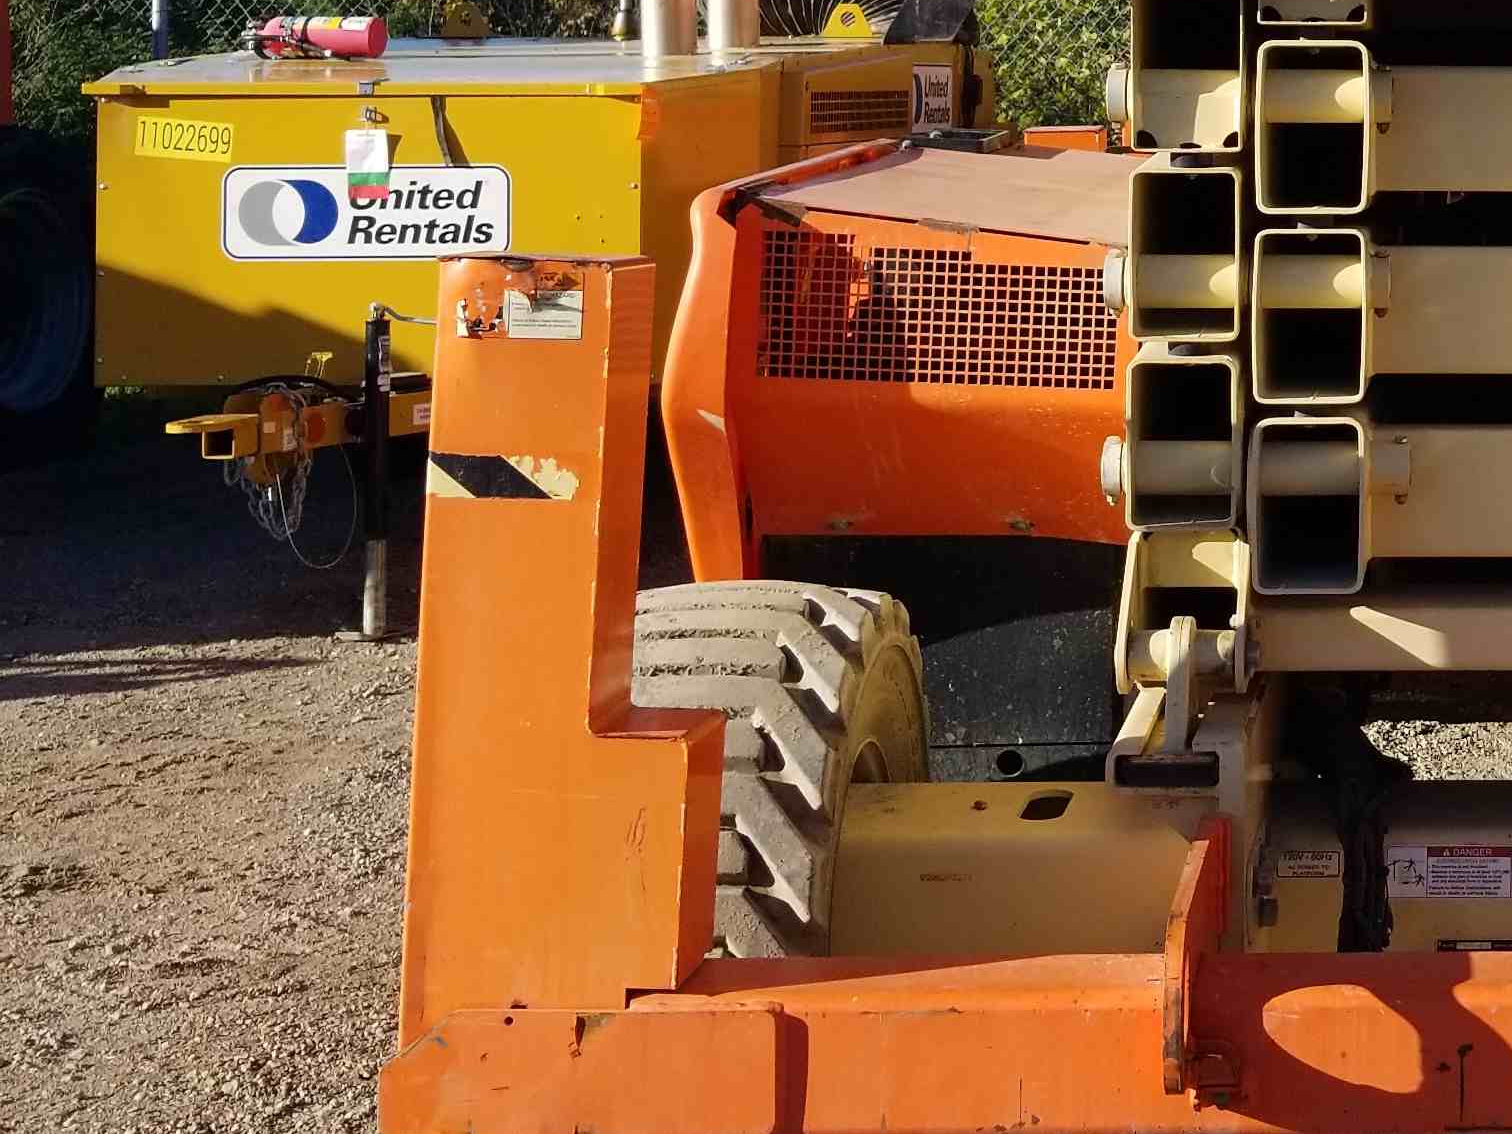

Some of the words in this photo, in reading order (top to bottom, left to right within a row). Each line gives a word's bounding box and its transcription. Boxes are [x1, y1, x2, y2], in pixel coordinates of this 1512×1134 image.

[924, 74, 949, 98] United
[924, 100, 950, 123] Rentals
[140, 120, 231, 155] 11022699
[347, 215, 494, 244] Rentals
[1452, 848, 1493, 857] DANGER
